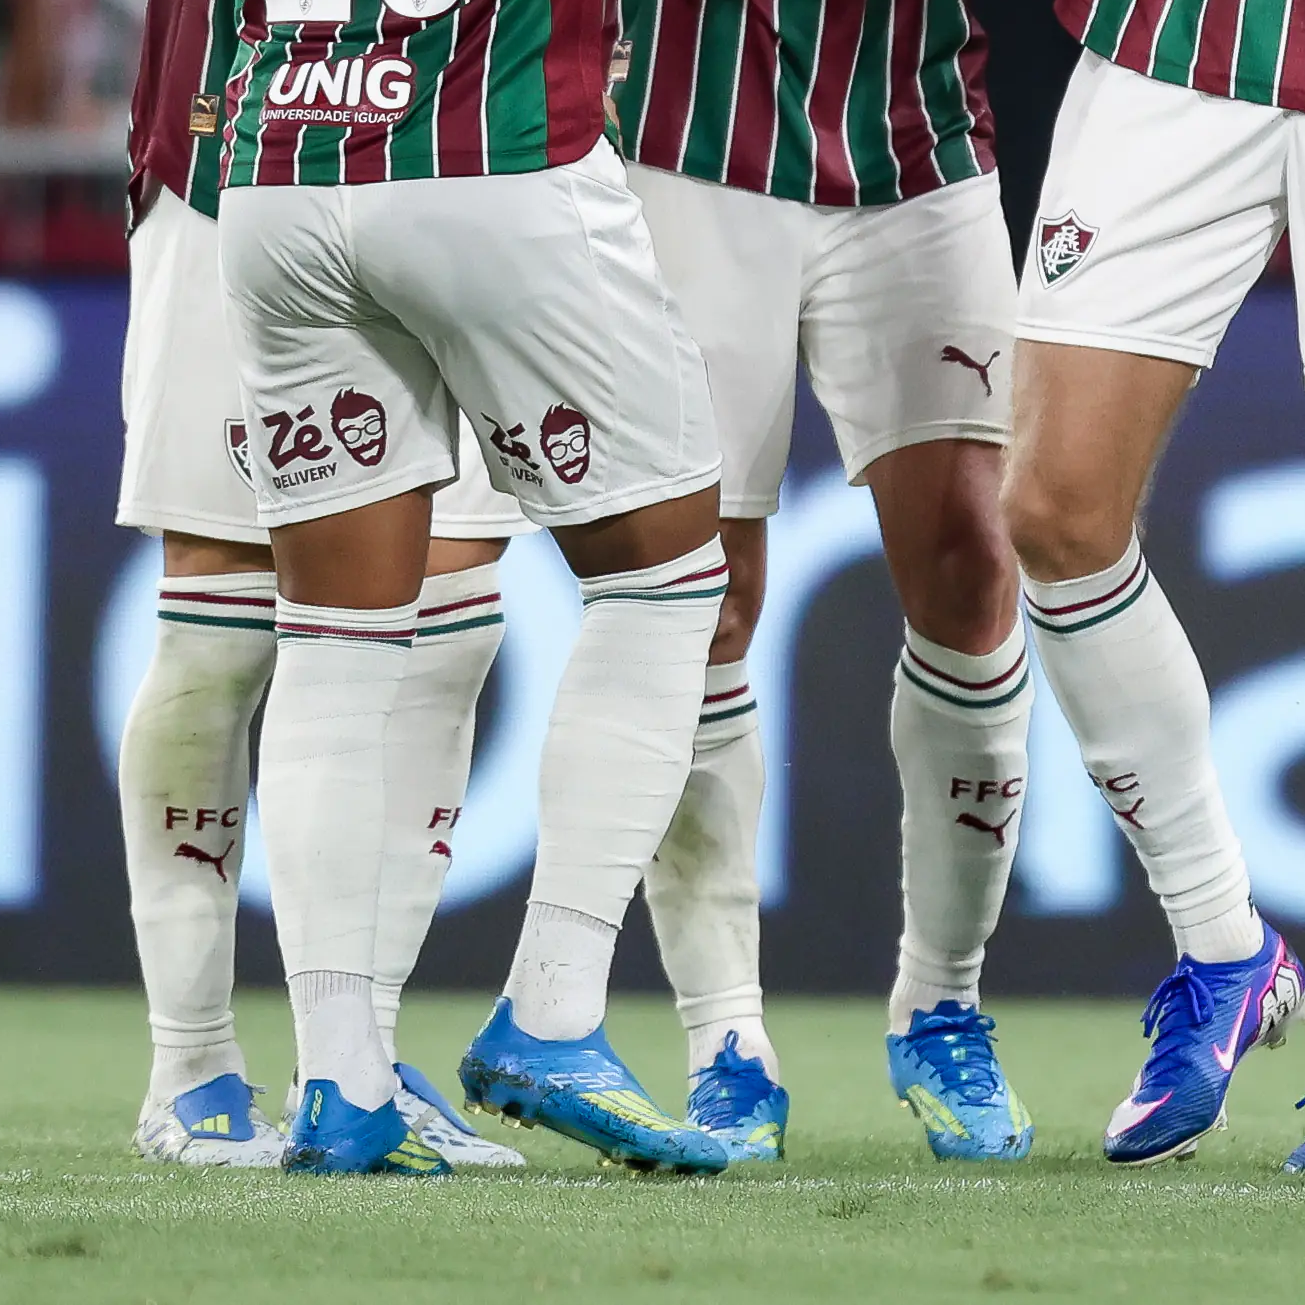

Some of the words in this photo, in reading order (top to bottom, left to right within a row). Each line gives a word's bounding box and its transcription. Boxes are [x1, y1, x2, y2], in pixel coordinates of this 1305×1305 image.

[268, 58, 412, 110] UNIG
[262, 108, 351, 123] UNIVERSIDADE
[354, 110, 404, 124] IGUAÇU
[260, 404, 333, 471] Zé
[272, 462, 337, 490] DELIVERY
[950, 776, 1024, 803] FFC
[165, 806, 240, 832] FFC
